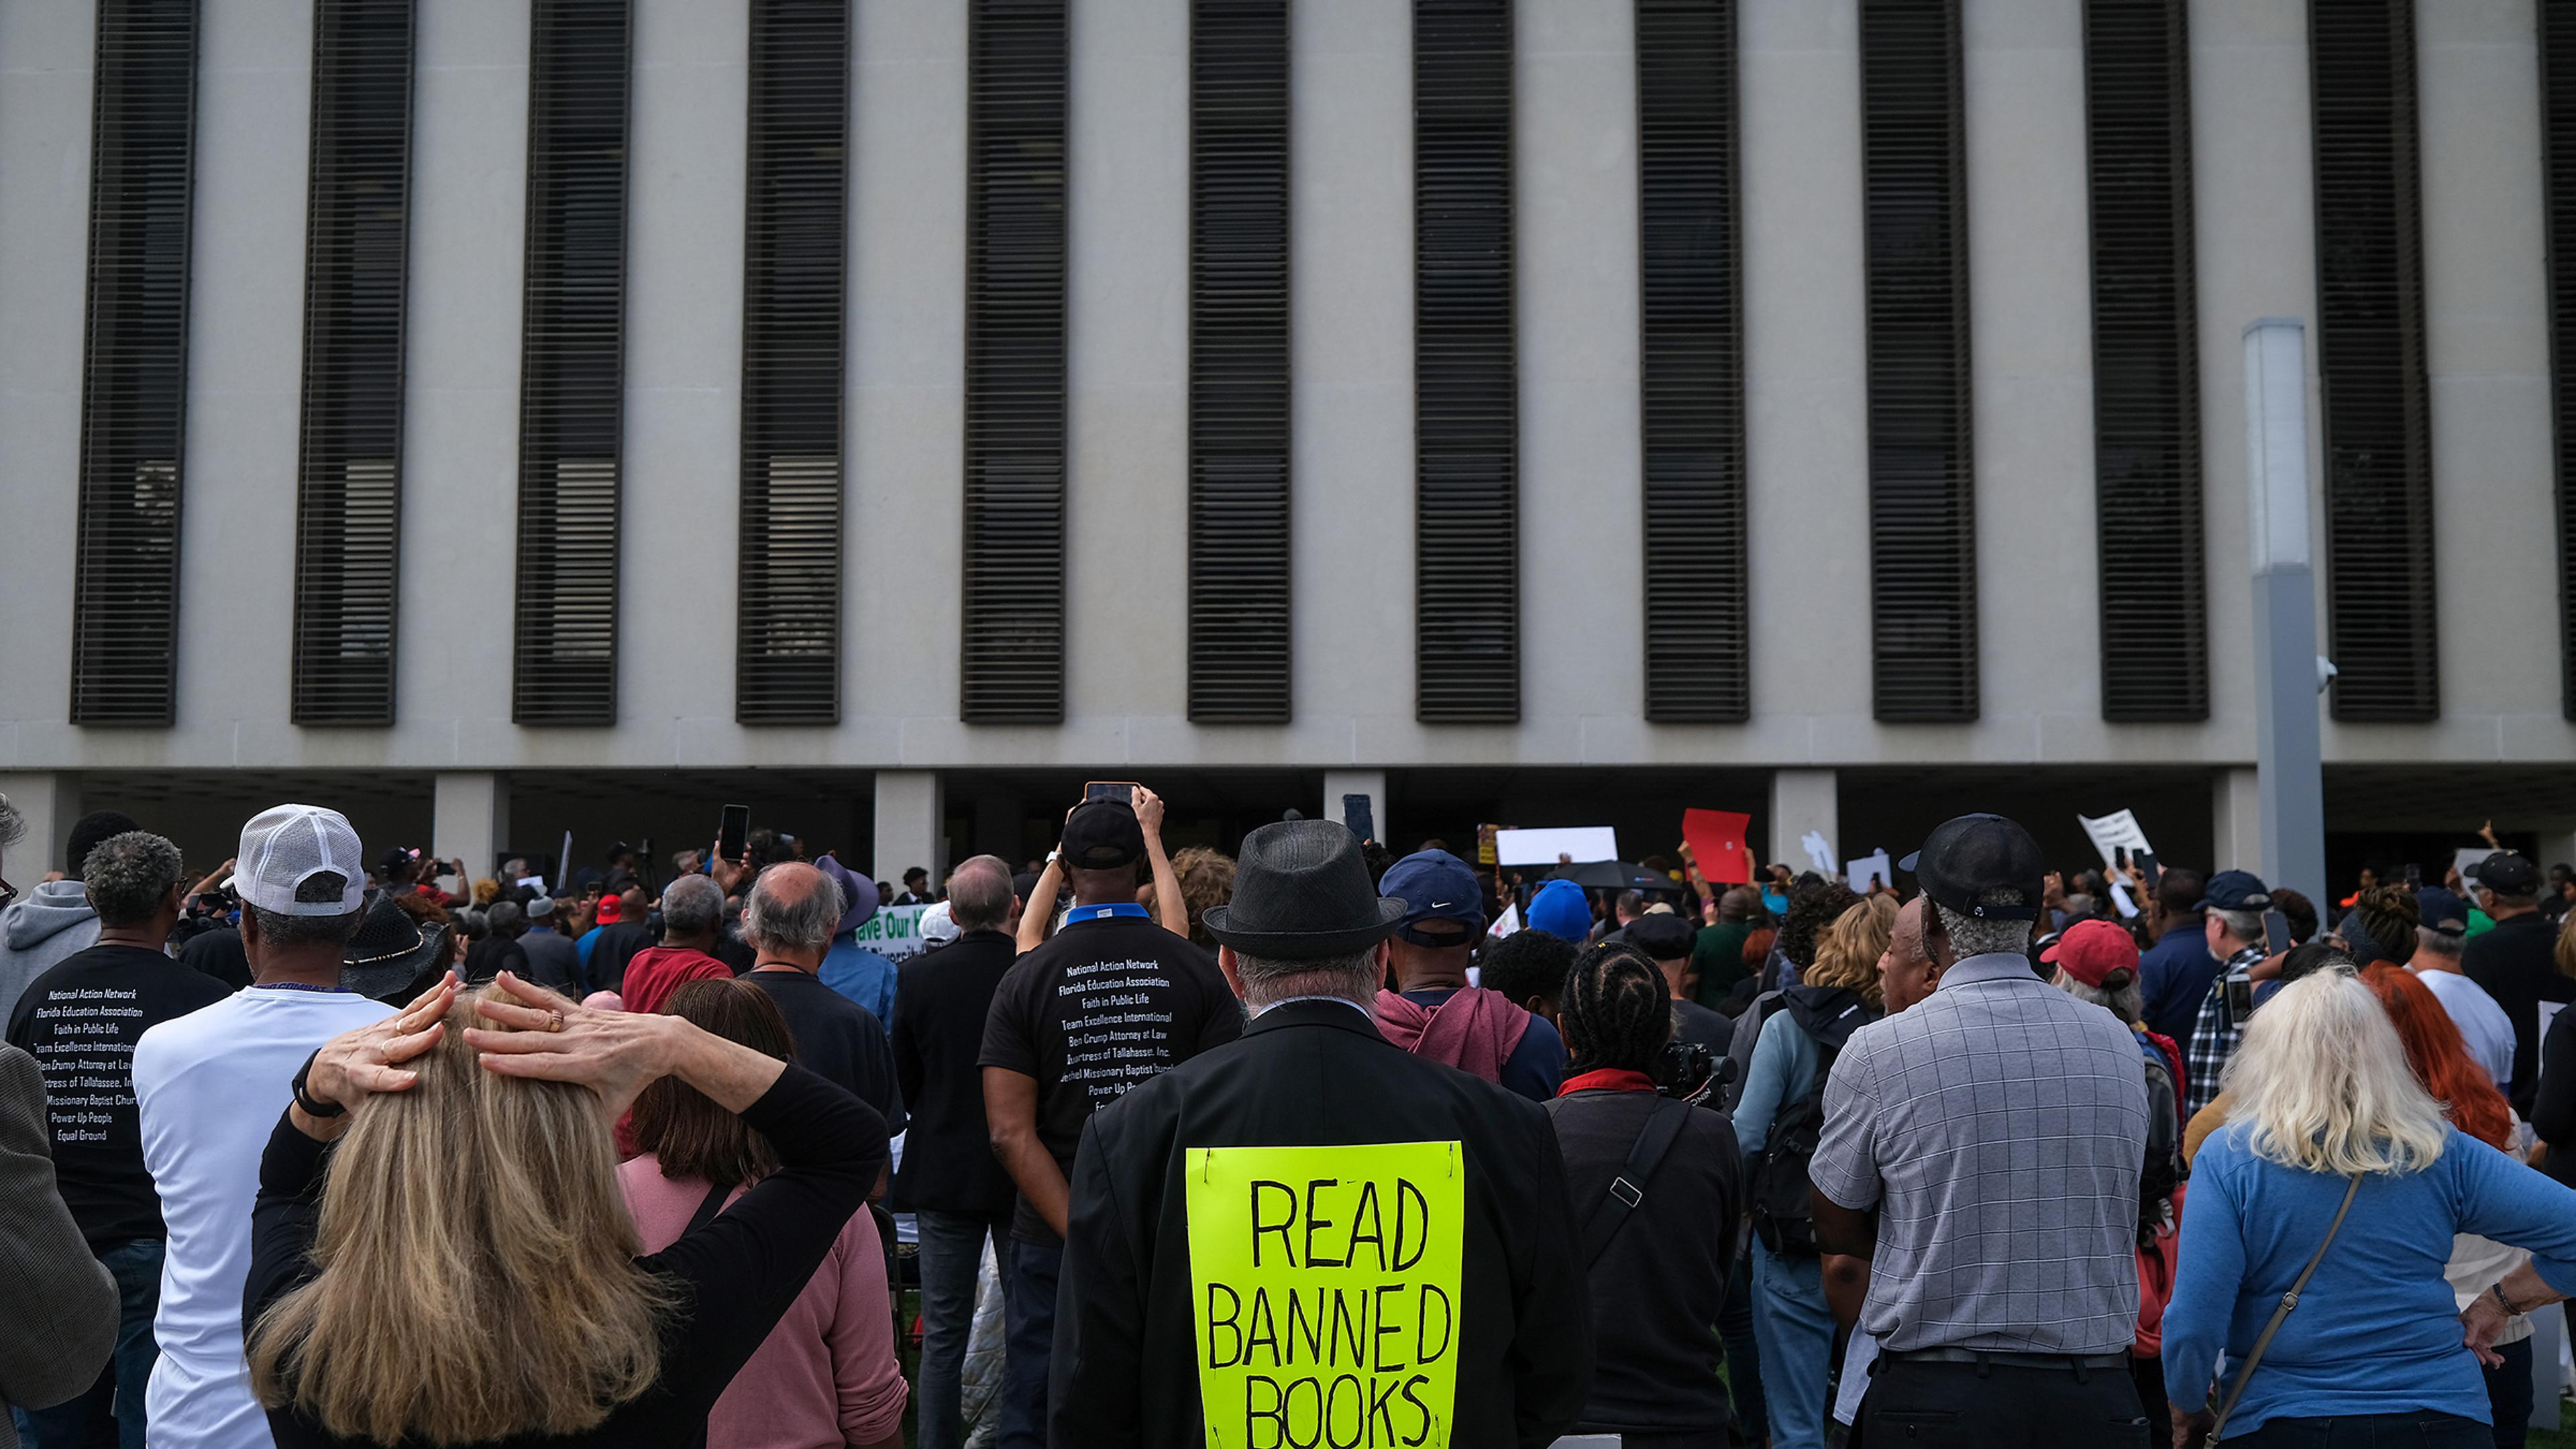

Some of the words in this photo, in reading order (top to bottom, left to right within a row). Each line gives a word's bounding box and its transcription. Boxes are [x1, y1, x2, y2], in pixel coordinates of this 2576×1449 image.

[857, 919, 881, 941] ave
[885, 912, 910, 939] Our
[1067, 961, 1098, 977] National
[1100, 961, 1124, 971] Action
[1126, 959, 1159, 969] Network
[1059, 982, 1086, 996] Florida
[1087, 979, 1124, 991] Education
[1126, 976, 1170, 987] Association
[48, 989, 78, 1000] National
[78, 989, 103, 999] Action
[104, 988, 136, 999] Network
[1082, 997, 1100, 1009] Faith
[1102, 997, 1109, 1006] in
[1111, 994, 1134, 1006] Public
[1135, 993, 1149, 1004] Life
[36, 1007, 60, 1018] Florida
[62, 1006, 98, 1017] Education
[100, 1006, 143, 1017] Association
[1061, 1020, 1083, 1031] Team
[1084, 1014, 1122, 1026] Excellence
[1124, 1012, 1172, 1022] International
[54, 1024, 72, 1034] Faith
[74, 1024, 80, 1034] in
[83, 1023, 104, 1034] Public
[106, 1023, 119, 1034] Life
[1069, 1036, 1082, 1047] Ben
[1083, 1033, 1107, 1044] Crump
[1110, 1030, 1141, 1041] Attorney
[1142, 1030, 1150, 1038] at
[1151, 1028, 1167, 1039] Law
[34, 1043, 52, 1053] eam
[54, 1041, 92, 1053] Excellence
[93, 1041, 135, 1053] Internationa
[1103, 1048, 1111, 1059] of
[1157, 1046, 1171, 1057] Inc.
[78, 1059, 106, 1071] Attorney
[108, 1061, 116, 1069] at
[1083, 1067, 1124, 1078] Missionary
[1126, 1064, 1153, 1077] Baptist
[44, 1079, 67, 1087] rtress
[70, 1076, 78, 1087] of
[124, 1077, 132, 1087] In
[1089, 1085, 1112, 1095] Power
[1114, 1083, 1125, 1095] Up
[46, 1095, 88, 1106] Missionary
[90, 1094, 113, 1106] Baptist
[115, 1094, 137, 1106] Chur
[51, 1112, 76, 1123] Power
[77, 1112, 87, 1124] Up
[89, 1112, 112, 1124] People
[58, 1130, 77, 1142] Equal
[80, 1130, 107, 1140] Ground
[1250, 1178, 1428, 1272] READ
[1208, 1283, 1452, 1373] BANNED
[1246, 1374, 1431, 1449] BOOKS
